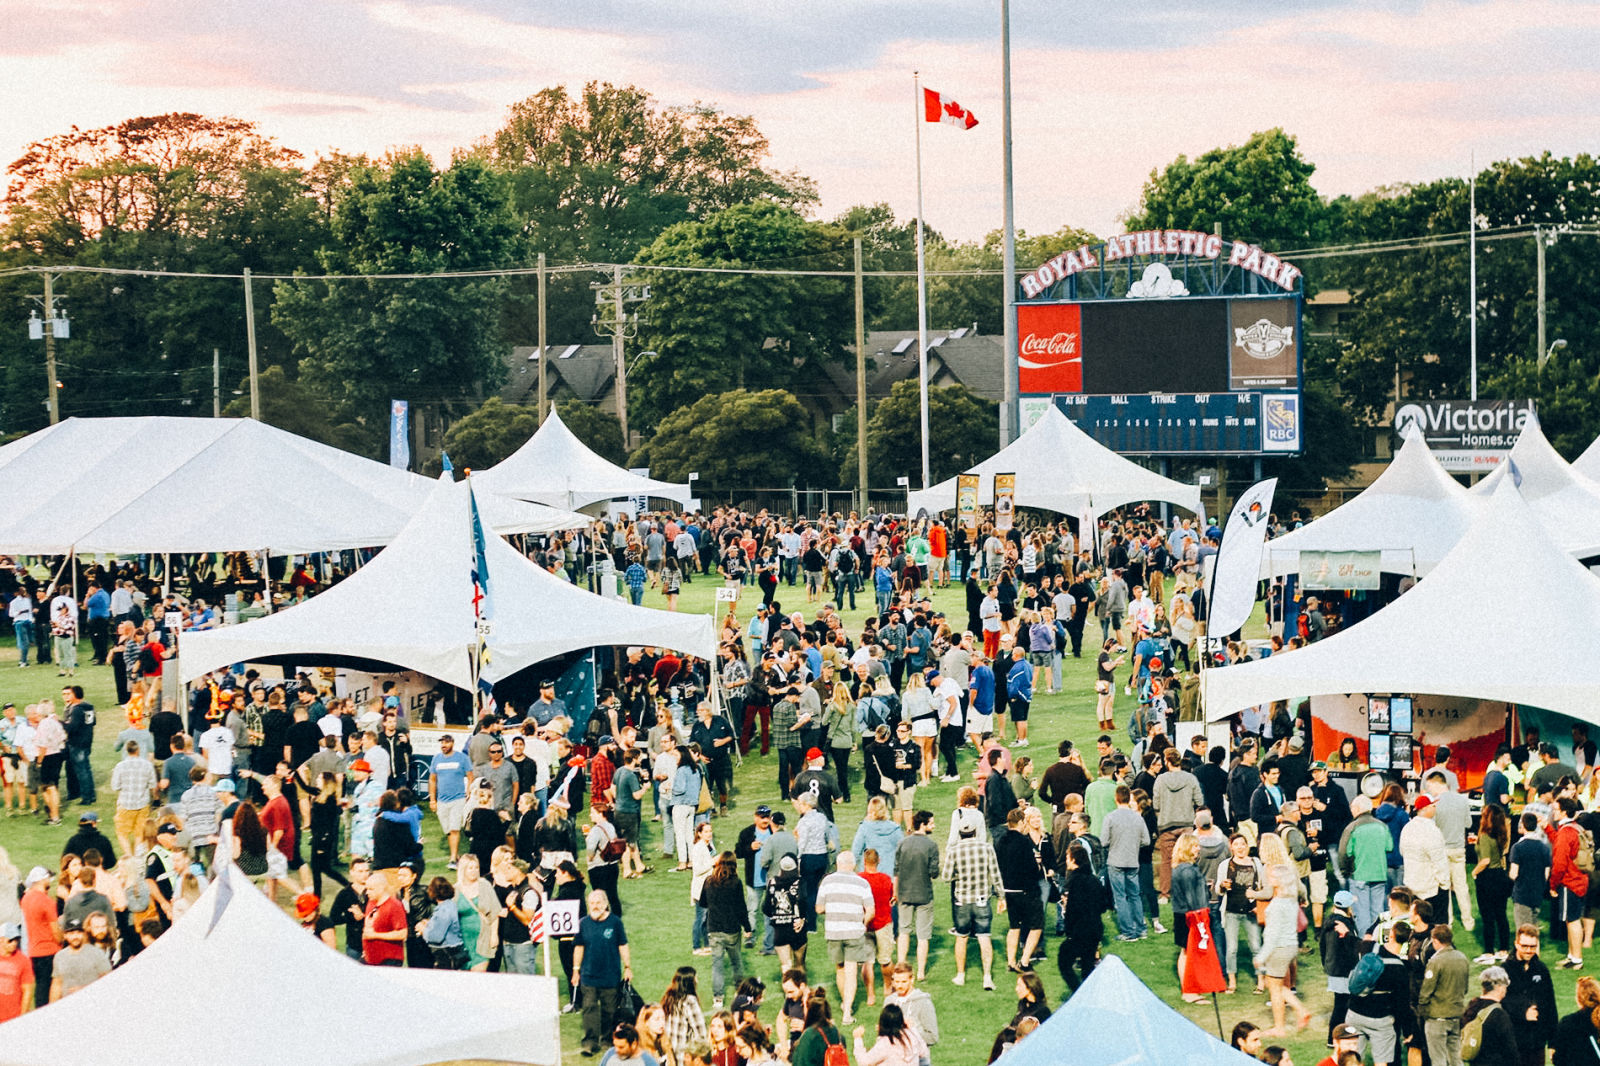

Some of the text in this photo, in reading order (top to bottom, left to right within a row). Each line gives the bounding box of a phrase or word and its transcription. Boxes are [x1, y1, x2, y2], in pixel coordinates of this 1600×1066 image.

[1020, 229, 1302, 298] ROYAL ATHLETIC PARK
[1021, 332, 1078, 355] Coca-Cola
[1065, 394, 1251, 405] AT BAT BALL STRIKE OUT H/E
[1096, 419, 1100, 427] 1
[1104, 419, 1110, 427] 2
[1112, 419, 1118, 427] 3
[1126, 419, 1132, 427] 4
[1158, 419, 1162, 427] 7
[1189, 418, 1197, 427] 10
[1202, 418, 1219, 427] RUNS
[1425, 402, 1530, 431] Victoria
[1269, 429, 1294, 440] RBC
[720, 590, 733, 599] 54
[809, 779, 820, 798] 8
[551, 912, 572, 932] 68
